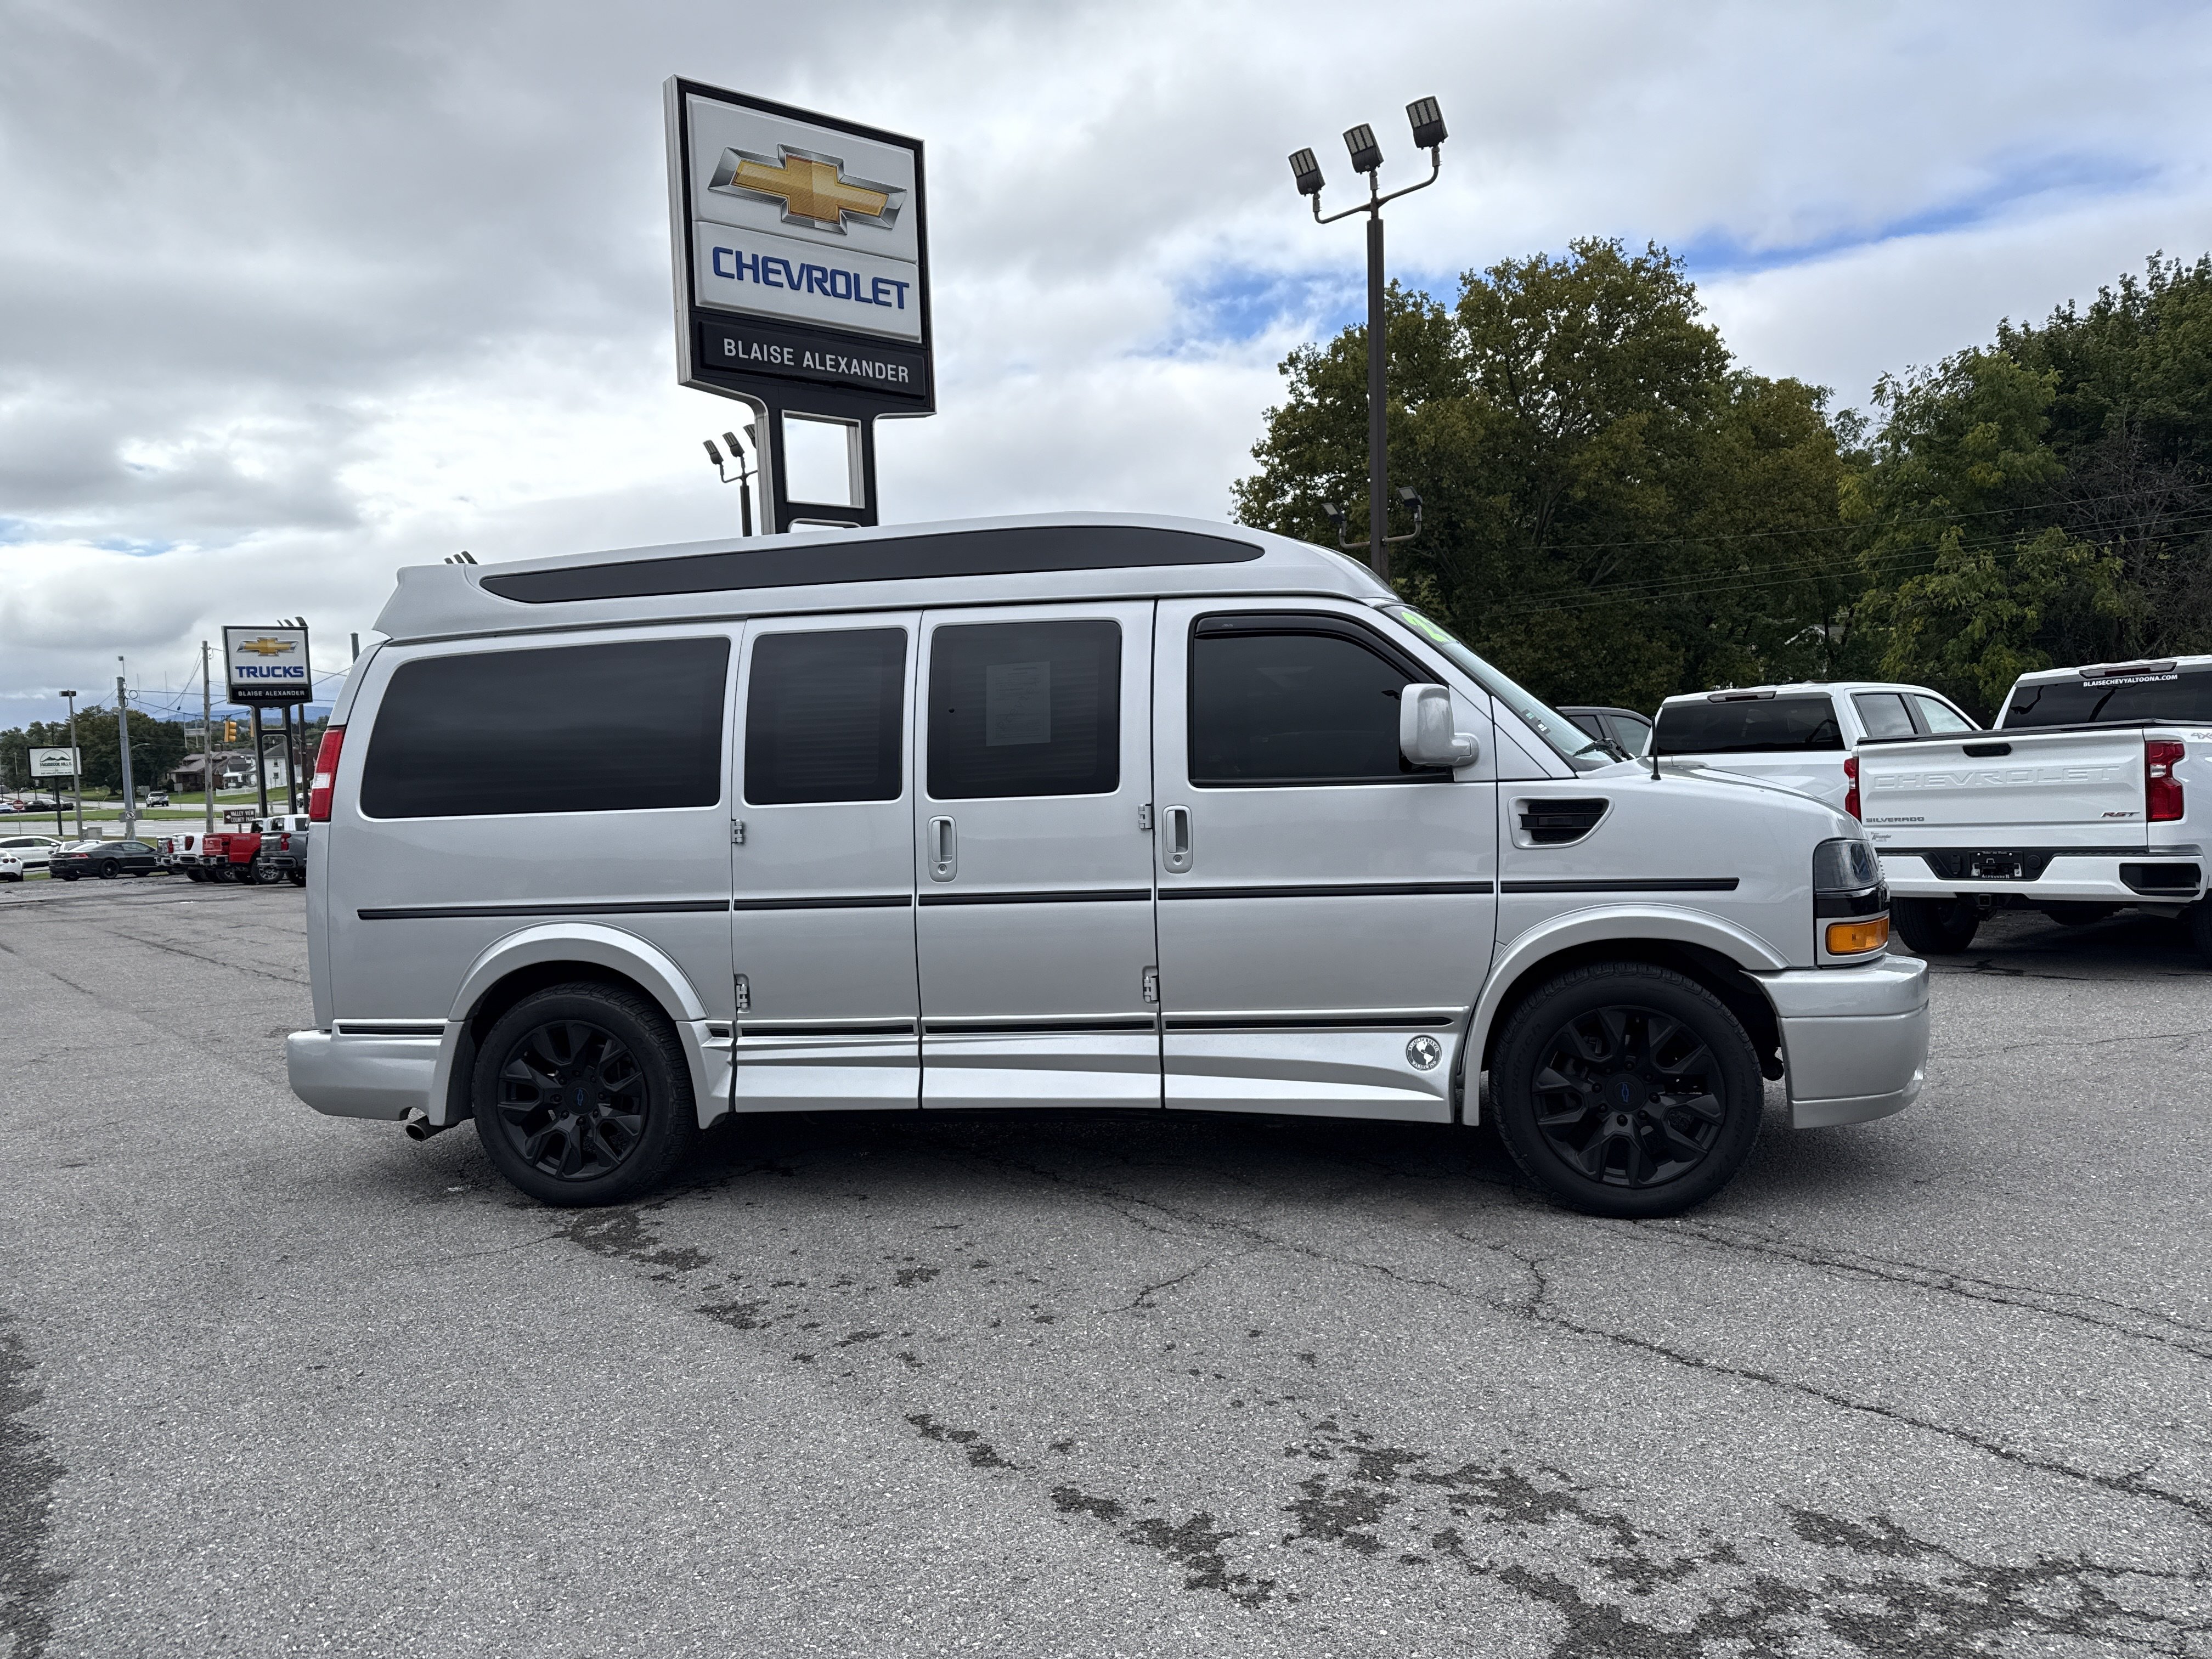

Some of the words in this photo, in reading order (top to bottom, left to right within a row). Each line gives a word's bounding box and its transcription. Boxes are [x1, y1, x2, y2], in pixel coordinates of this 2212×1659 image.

[713, 246, 910, 309] CHEVROLET
[724, 338, 794, 365] BLAISE
[803, 350, 909, 383] ALEXANDER
[235, 666, 304, 678] TRUCKS
[2083, 674, 2178, 687] BLAISECHEVYALTOONA.COM
[1874, 766, 2120, 789] CHEVROLET
